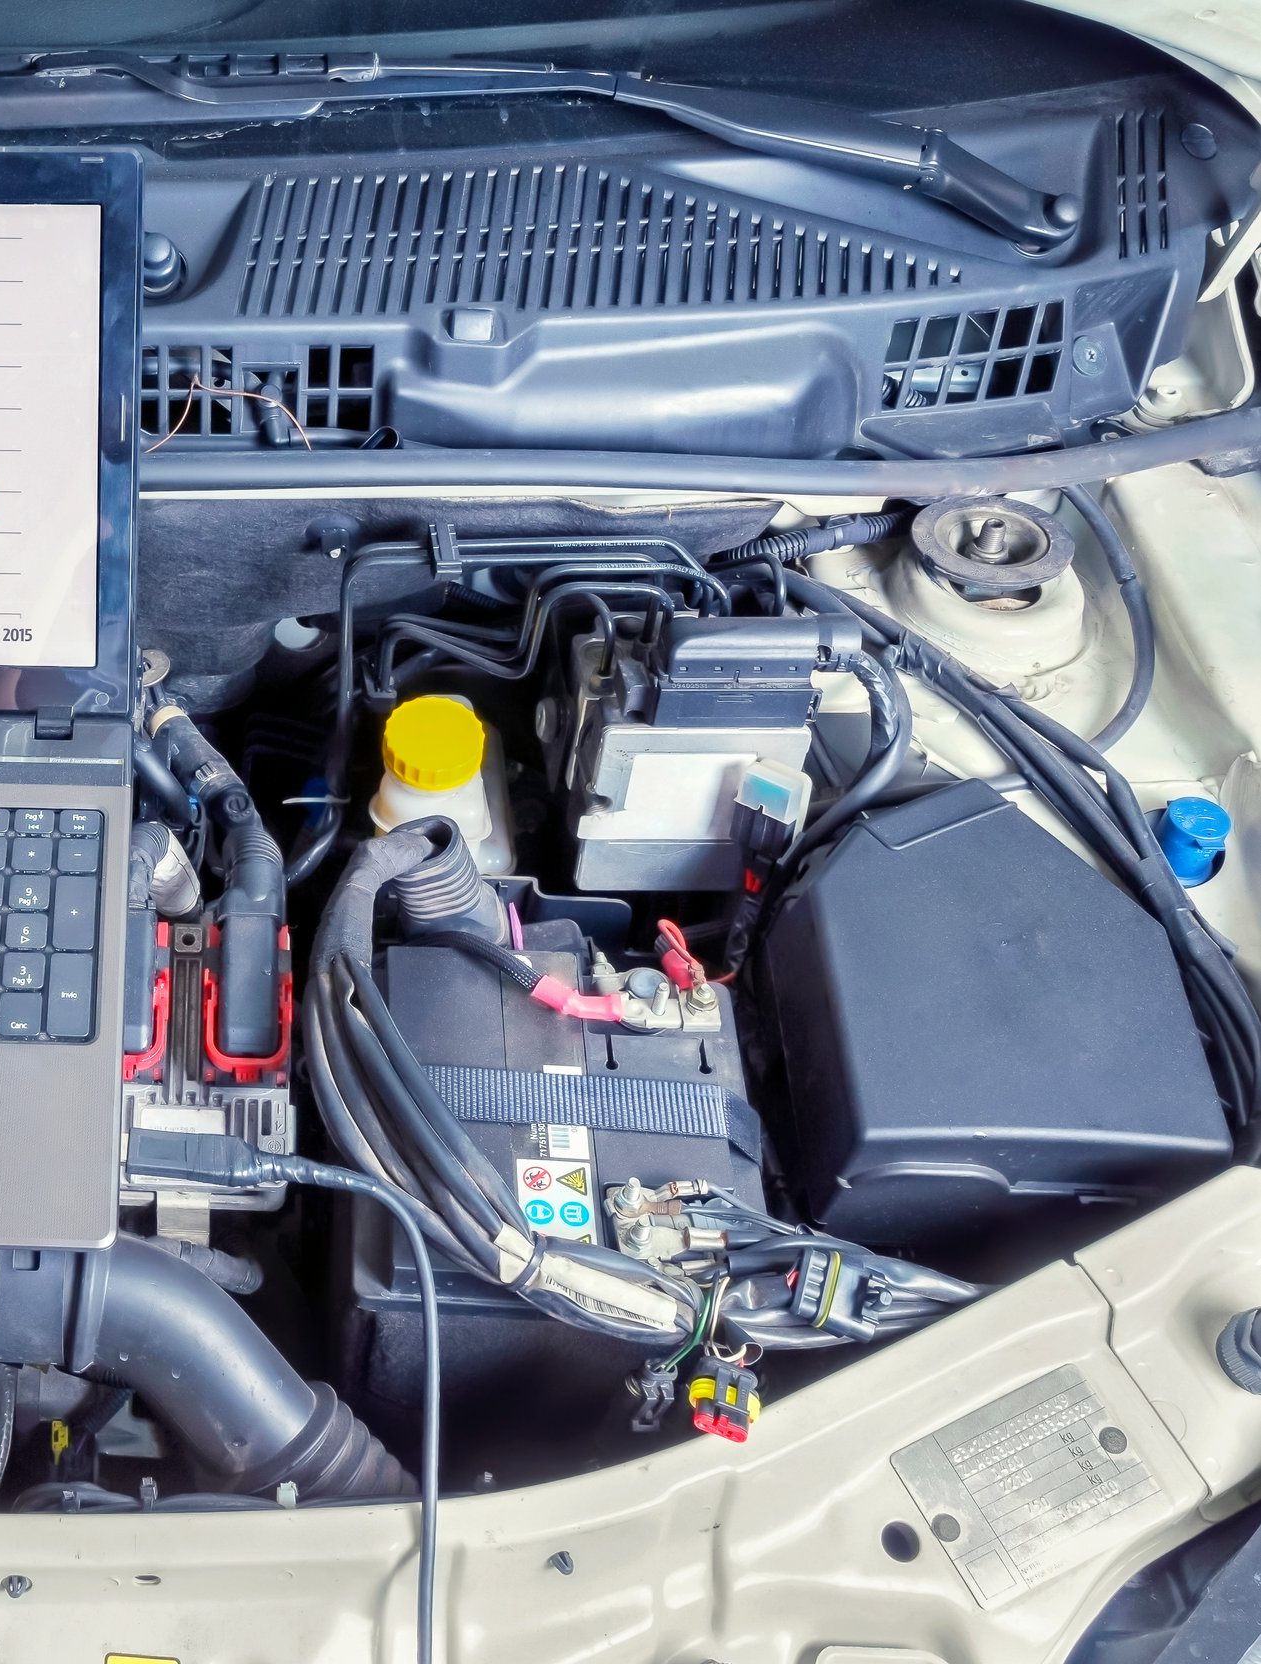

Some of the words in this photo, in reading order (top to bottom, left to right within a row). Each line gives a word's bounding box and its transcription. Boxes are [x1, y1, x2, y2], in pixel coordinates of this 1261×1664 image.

[3, 629, 32, 641] 2015
[24, 813, 38, 822] Pag
[72, 813, 87, 822] Fine
[25, 887, 33, 897] 9
[18, 897, 32, 907] Pag
[22, 926, 30, 936] 6
[19, 965, 27, 976] 3
[12, 976, 26, 986] Pag
[60, 991, 78, 999] Invio
[10, 1021, 28, 1030] Canc
[1059, 1432, 1075, 1444] kg
[1068, 1445, 1084, 1457] kg
[1077, 1459, 1093, 1471] kg
[1087, 1473, 1102, 1486] kg
